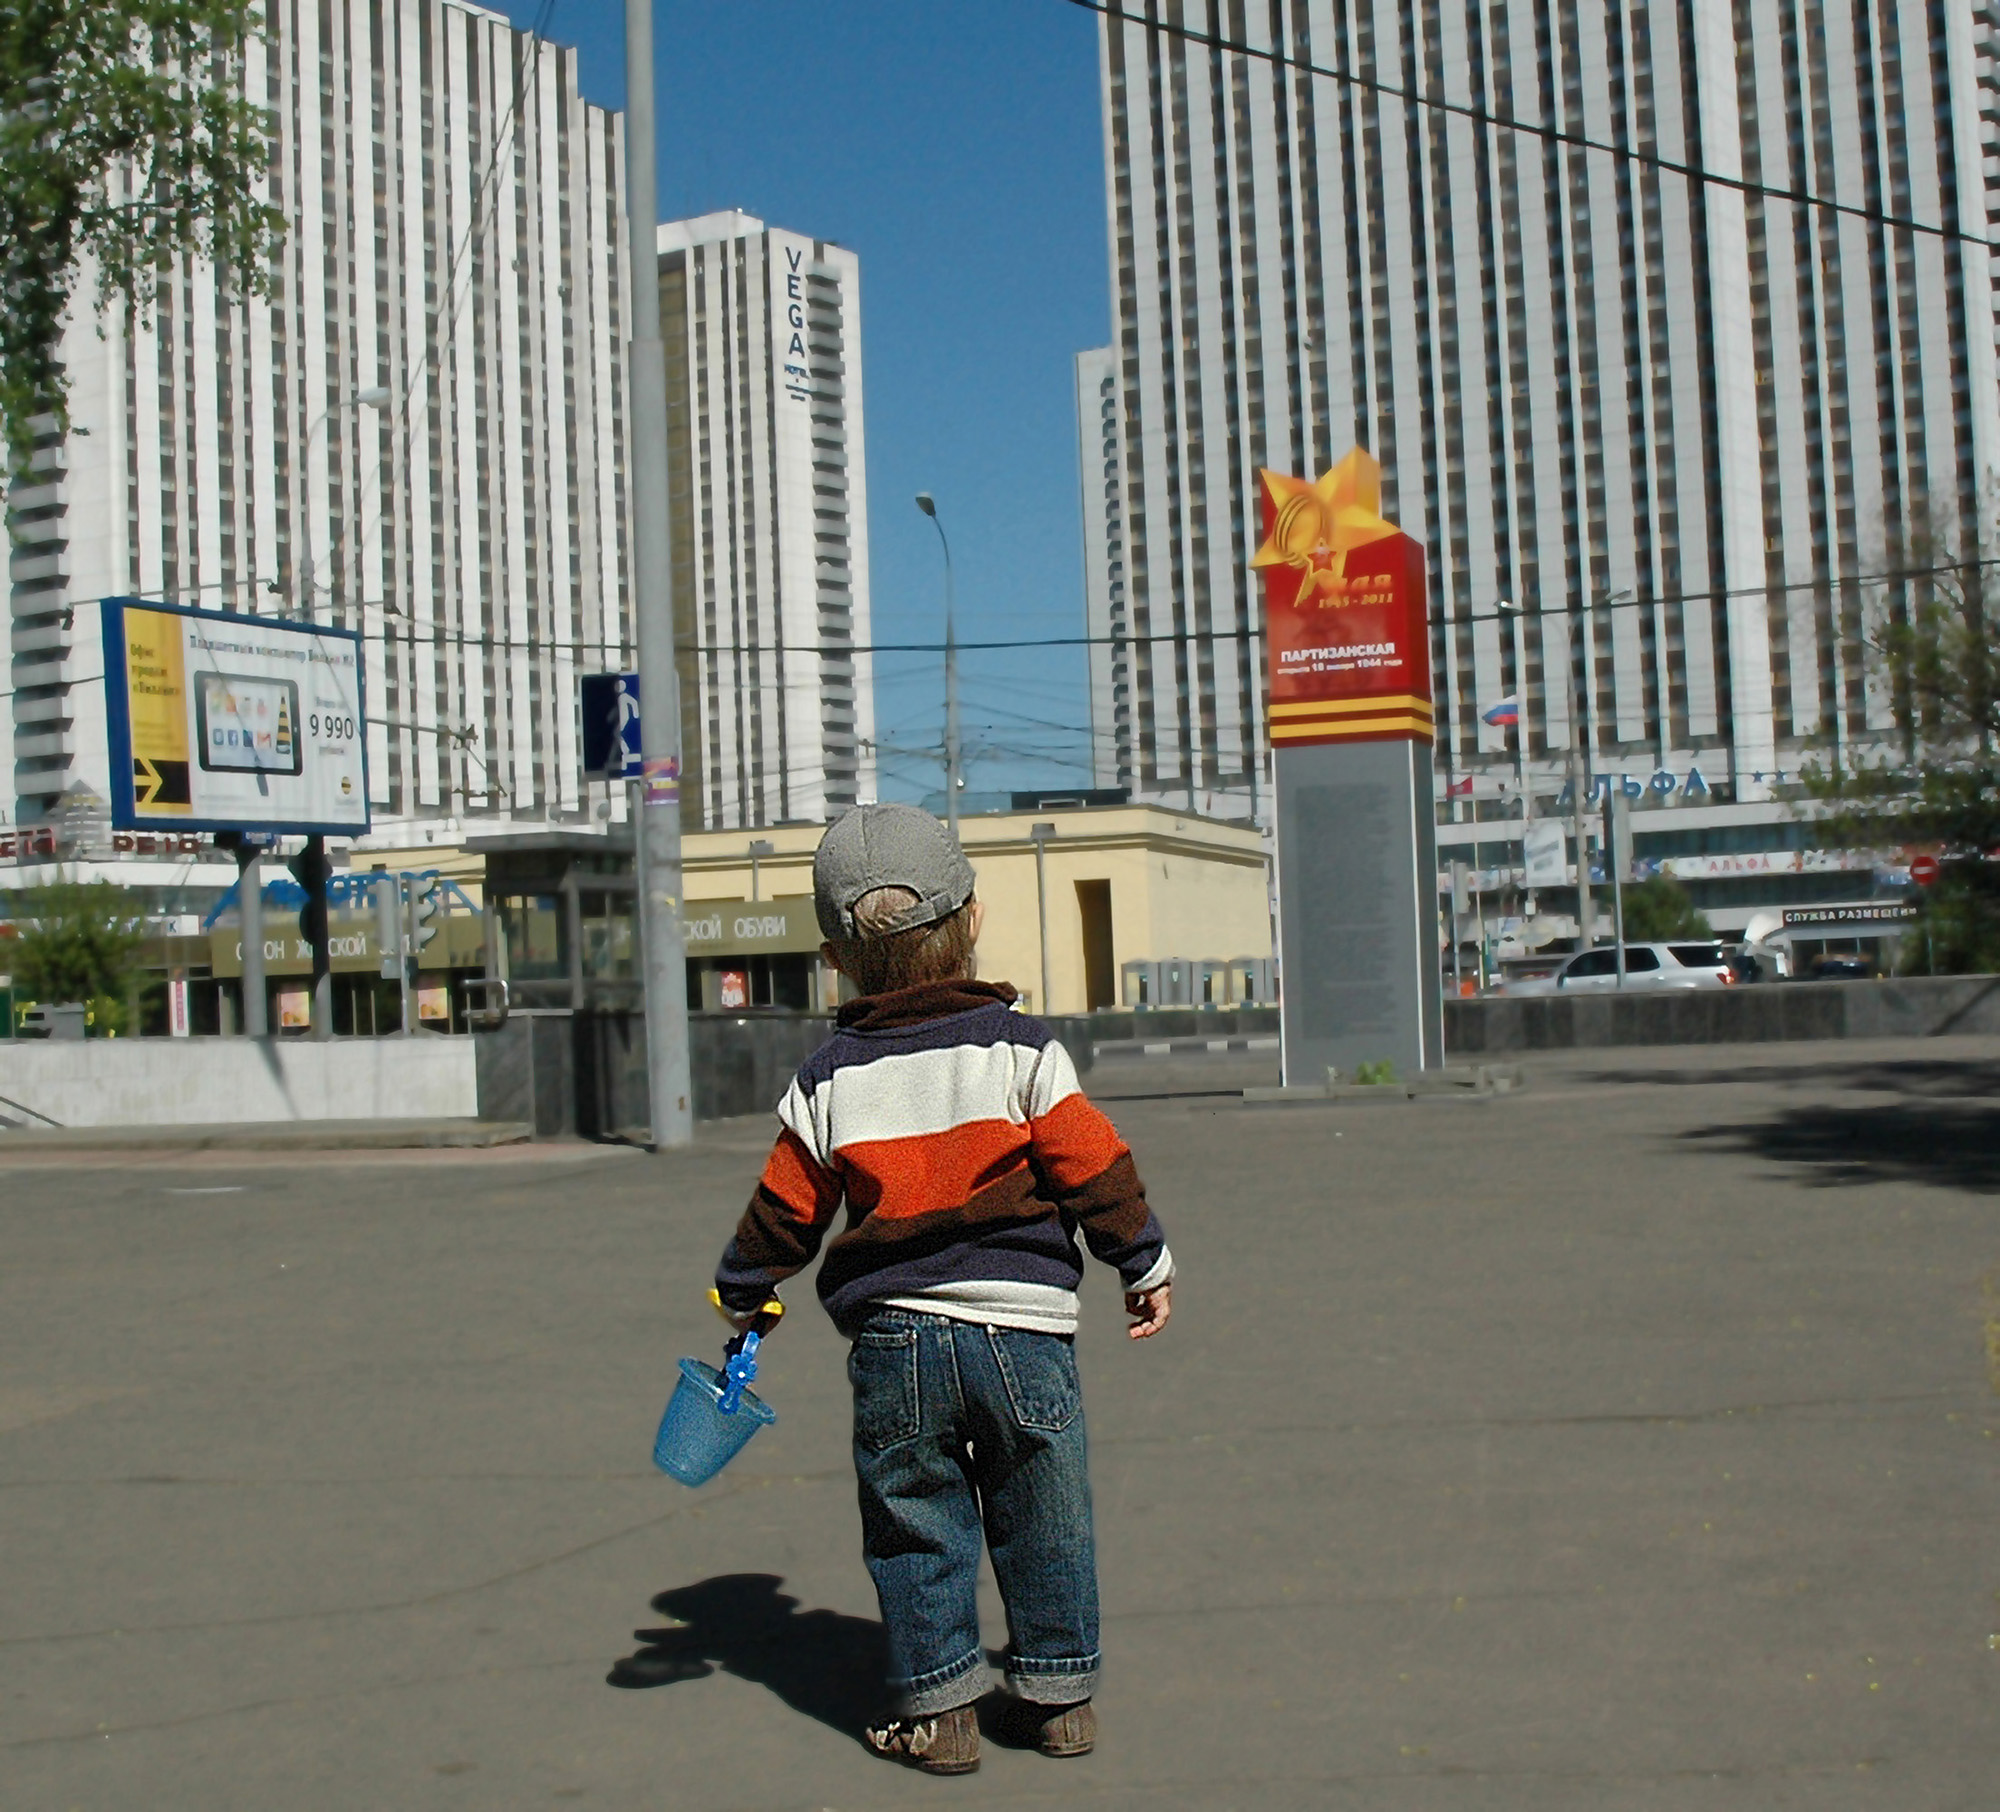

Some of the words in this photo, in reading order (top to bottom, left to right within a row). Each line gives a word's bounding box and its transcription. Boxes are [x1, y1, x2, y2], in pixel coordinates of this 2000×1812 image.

[785, 247, 805, 358] VEGA
[1281, 642, 1396, 663] ПАРТИЗАНСКАЯ
[734, 914, 786, 939] ОБУВИ
[1785, 910, 1836, 922] СЛУЖБА
